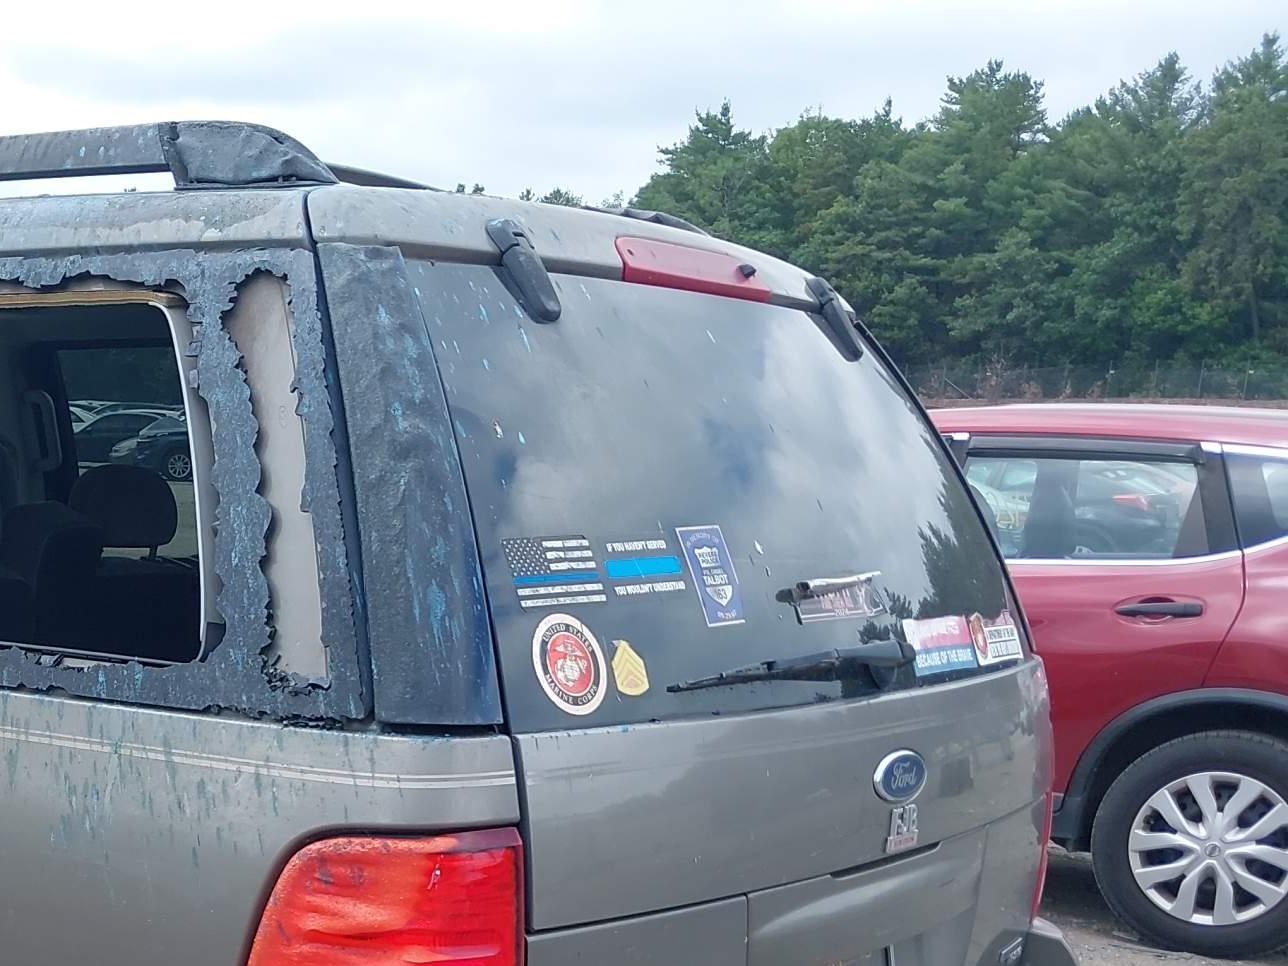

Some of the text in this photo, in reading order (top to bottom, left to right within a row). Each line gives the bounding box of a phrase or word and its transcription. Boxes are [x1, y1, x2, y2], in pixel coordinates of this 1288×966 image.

[612, 542, 625, 552] YOU
[703, 574, 728, 585] TALBOT
[614, 586, 627, 597] YOU
[543, 624, 593, 652] UNITED STATES
[916, 652, 941, 668] BECAUSE
[940, 651, 948, 665] OF
[947, 650, 958, 662] THE
[545, 674, 598, 705] MARINE CORPS
